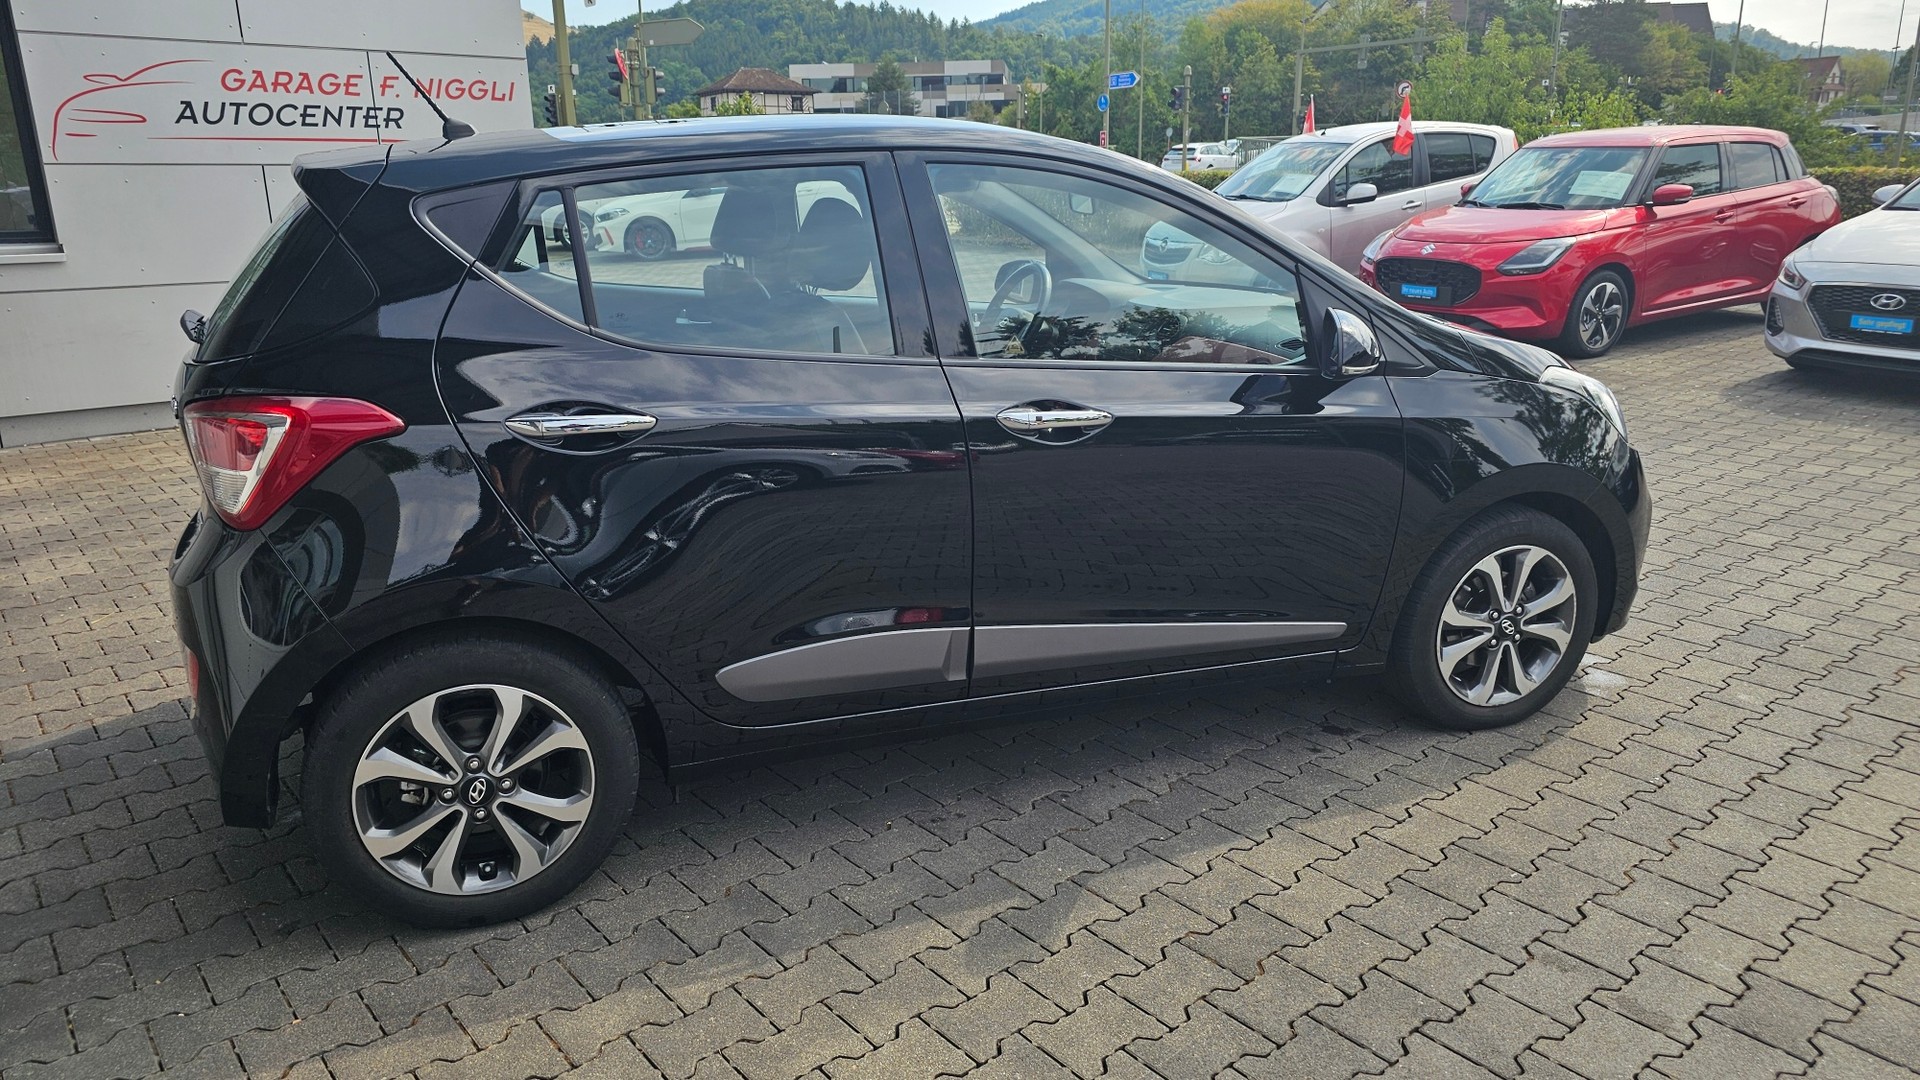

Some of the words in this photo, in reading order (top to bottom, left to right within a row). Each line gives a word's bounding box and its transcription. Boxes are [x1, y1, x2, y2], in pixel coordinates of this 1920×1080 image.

[220, 68, 363, 97] GARAGE
[380, 76, 400, 98] F.
[414, 78, 515, 101] NIGGLI
[175, 100, 405, 129] AUTOCENTER
